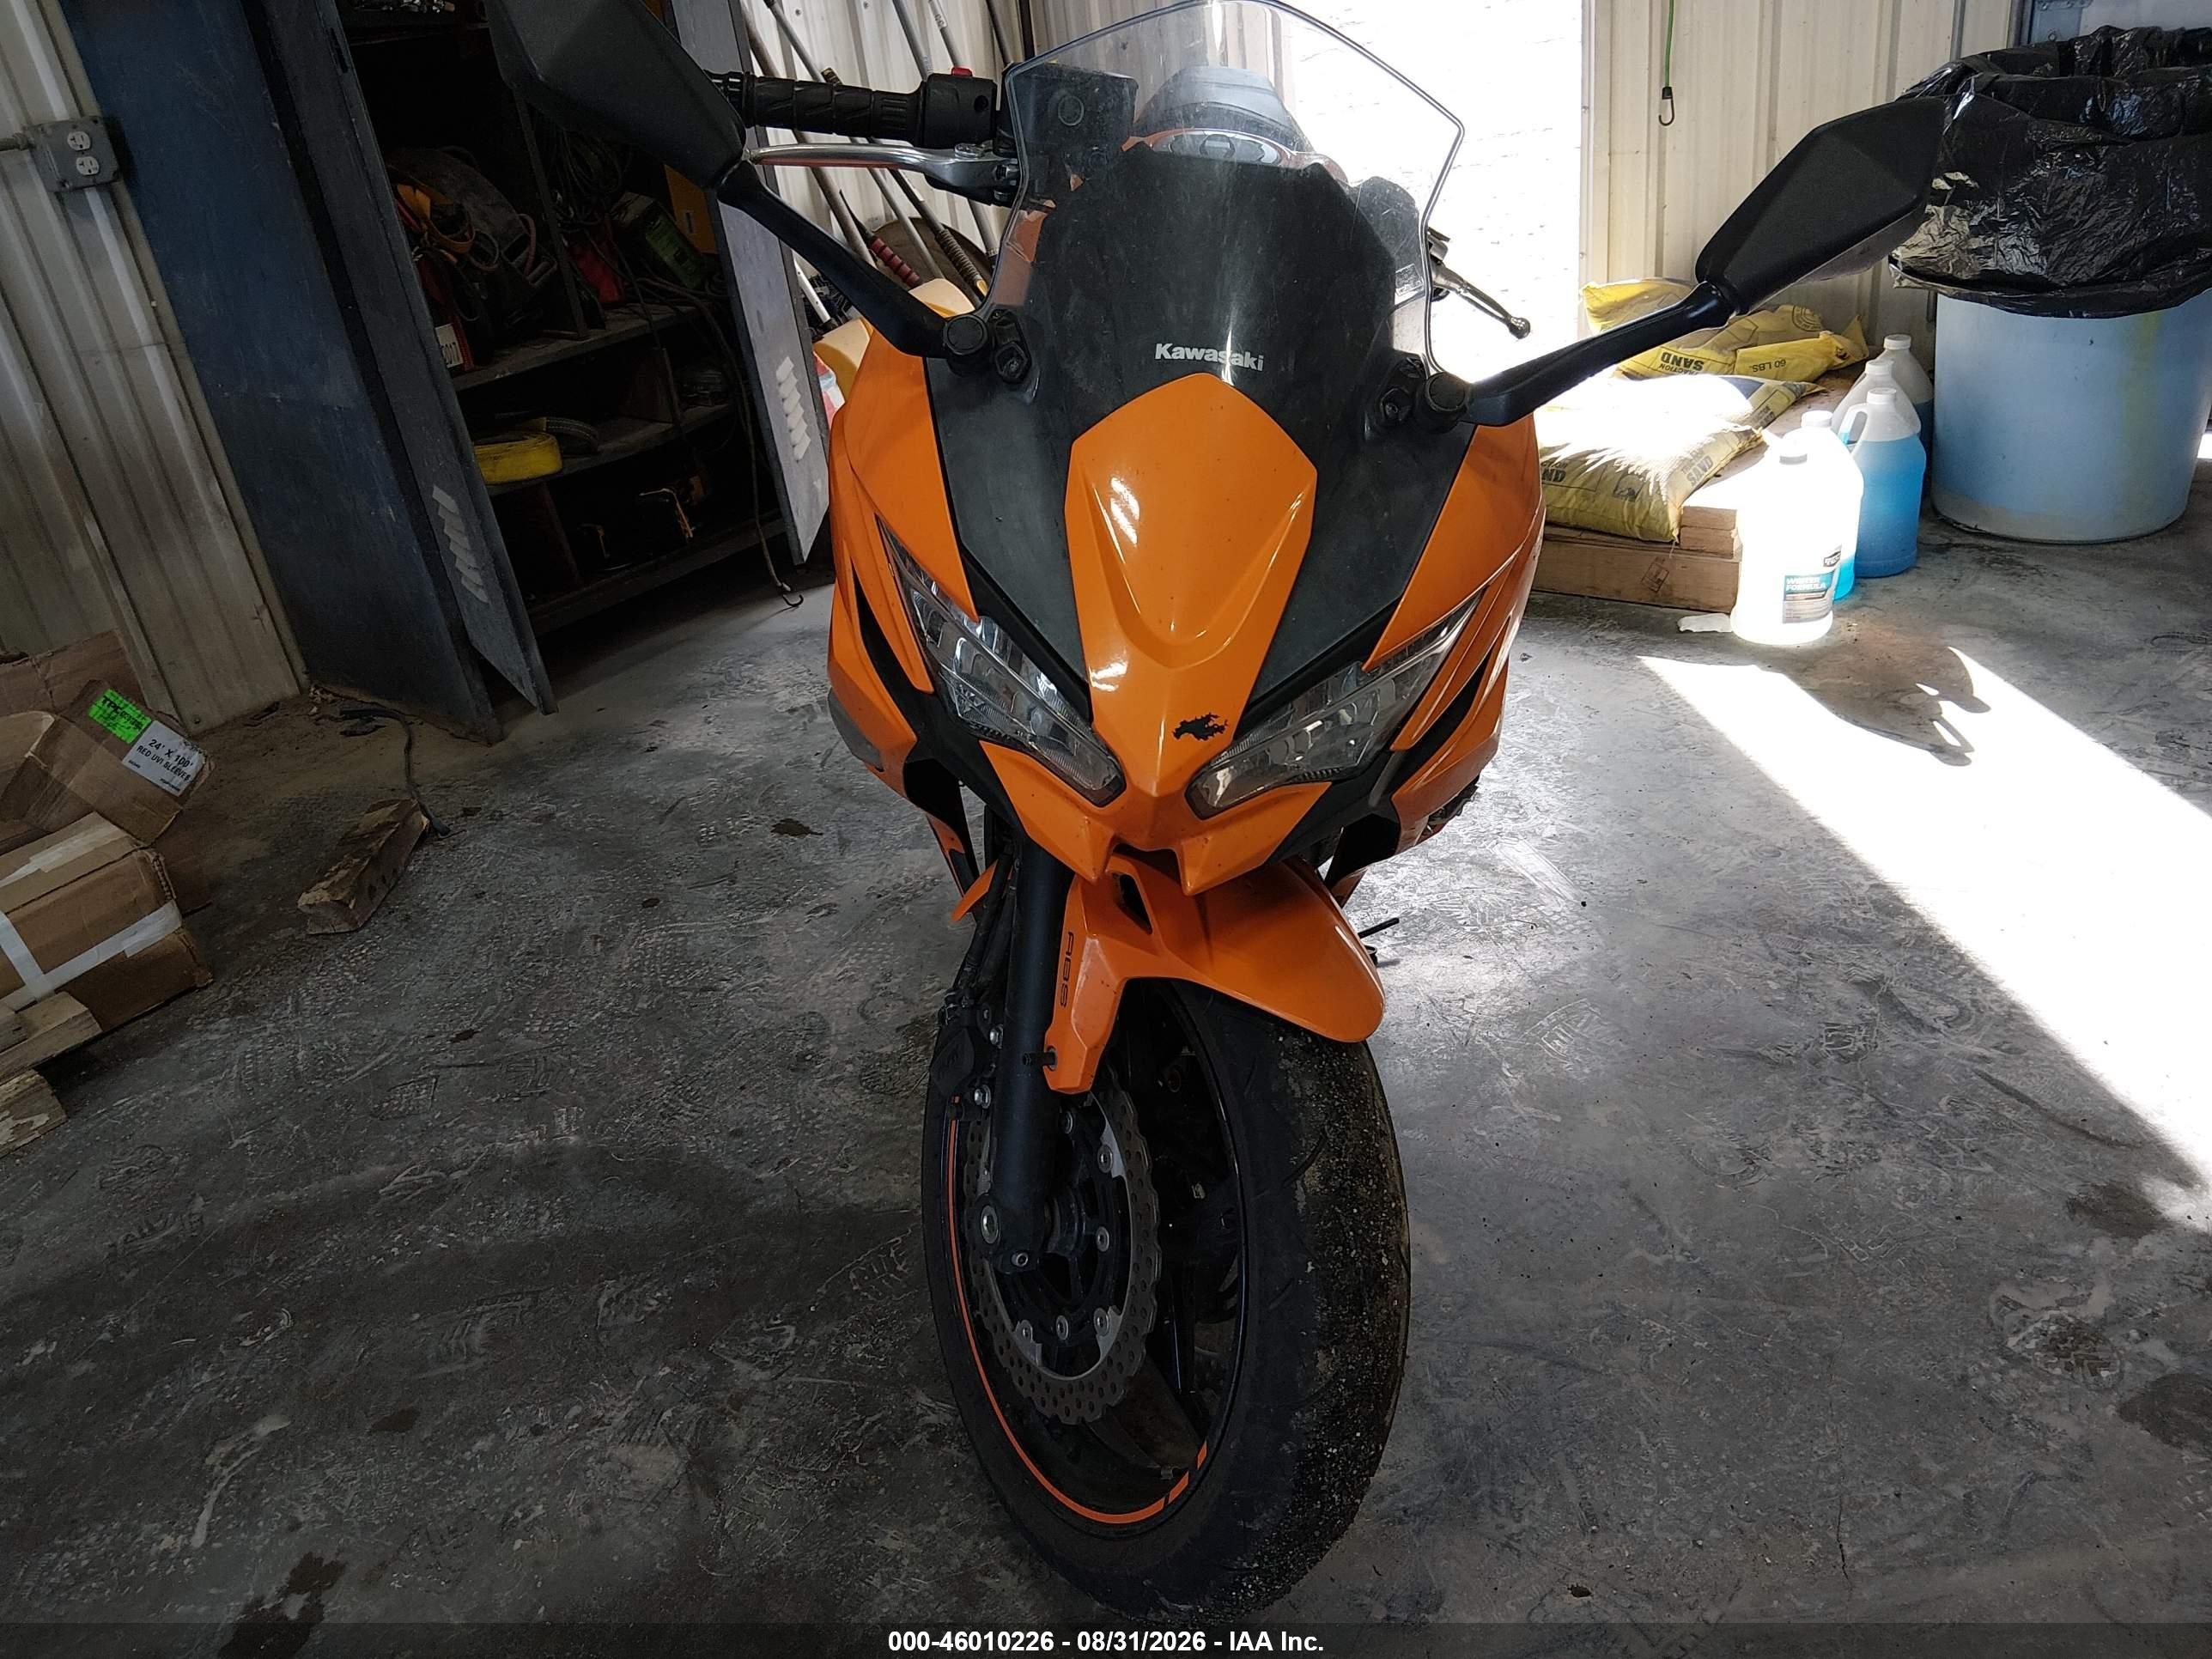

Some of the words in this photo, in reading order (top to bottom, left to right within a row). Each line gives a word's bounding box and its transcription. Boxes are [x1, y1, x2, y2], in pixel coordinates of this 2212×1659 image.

[1154, 343, 1264, 371] Kawasaki
[1661, 351, 1705, 371] SAND
[1773, 358, 1786, 368] 60
[149, 738, 165, 750] 24'
[137, 745, 151, 757] RED
[163, 761, 191, 781] SLEEVES
[1060, 931, 1074, 1008] ABS
